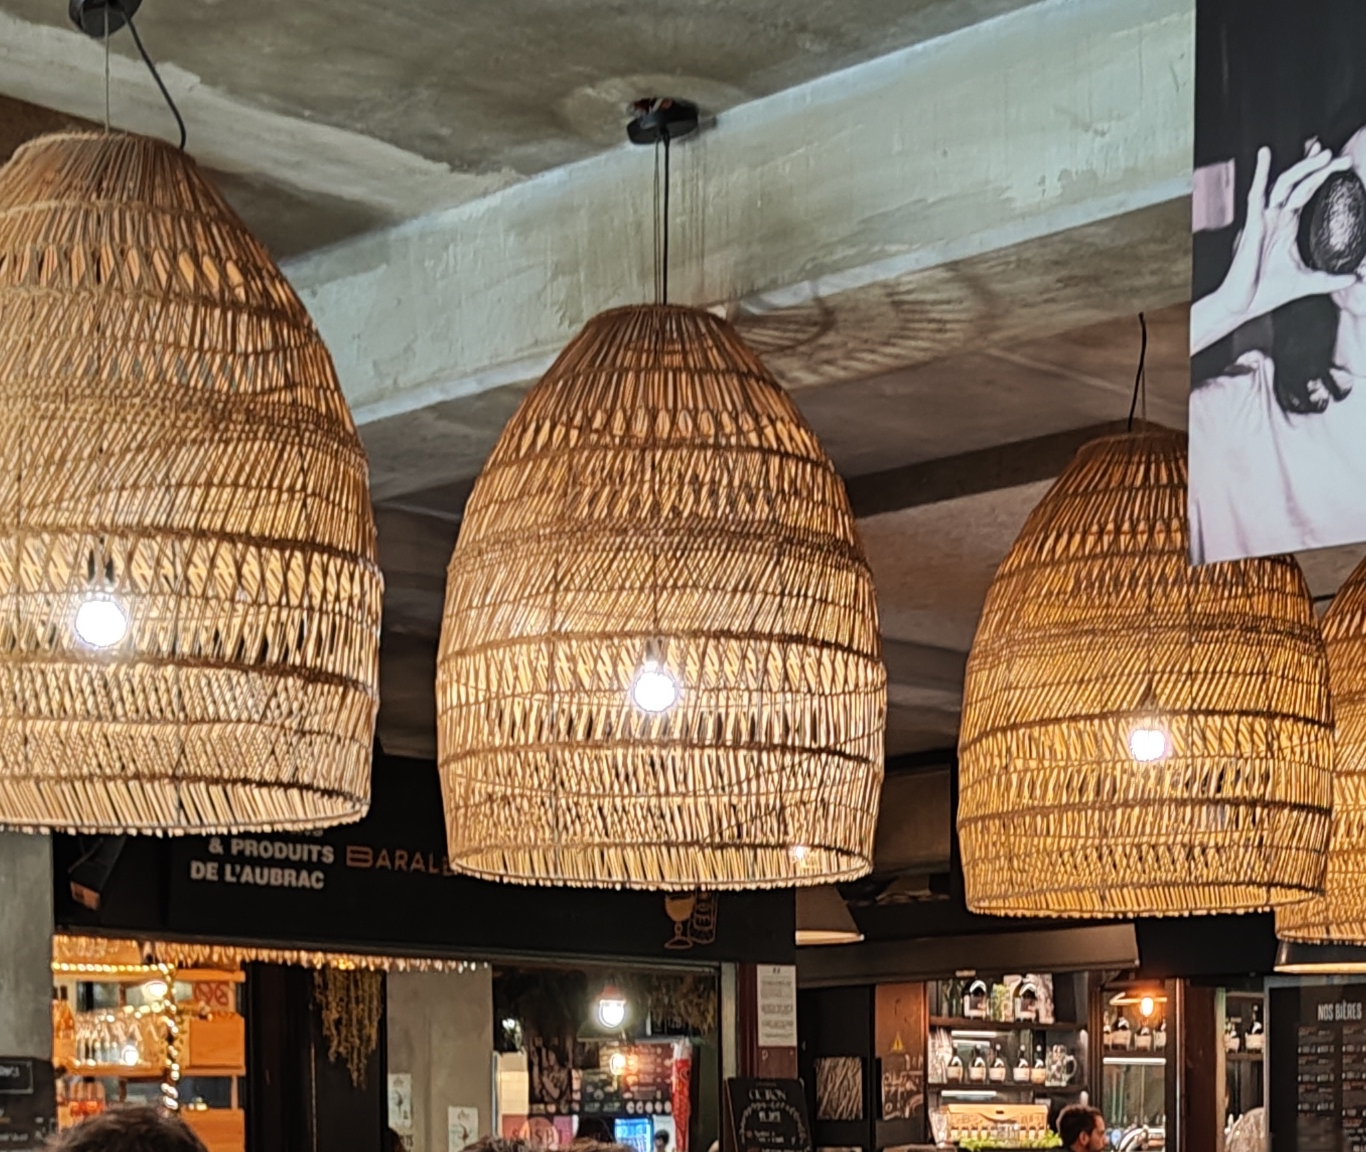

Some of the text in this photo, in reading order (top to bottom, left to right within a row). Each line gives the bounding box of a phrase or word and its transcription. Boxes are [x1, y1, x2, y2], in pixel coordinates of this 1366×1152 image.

[208, 836, 335, 864] & PRODUITS
[189, 860, 325, 891] DE L'AUBRAC
[1317, 999, 1363, 1022] NOS BIÈRES
